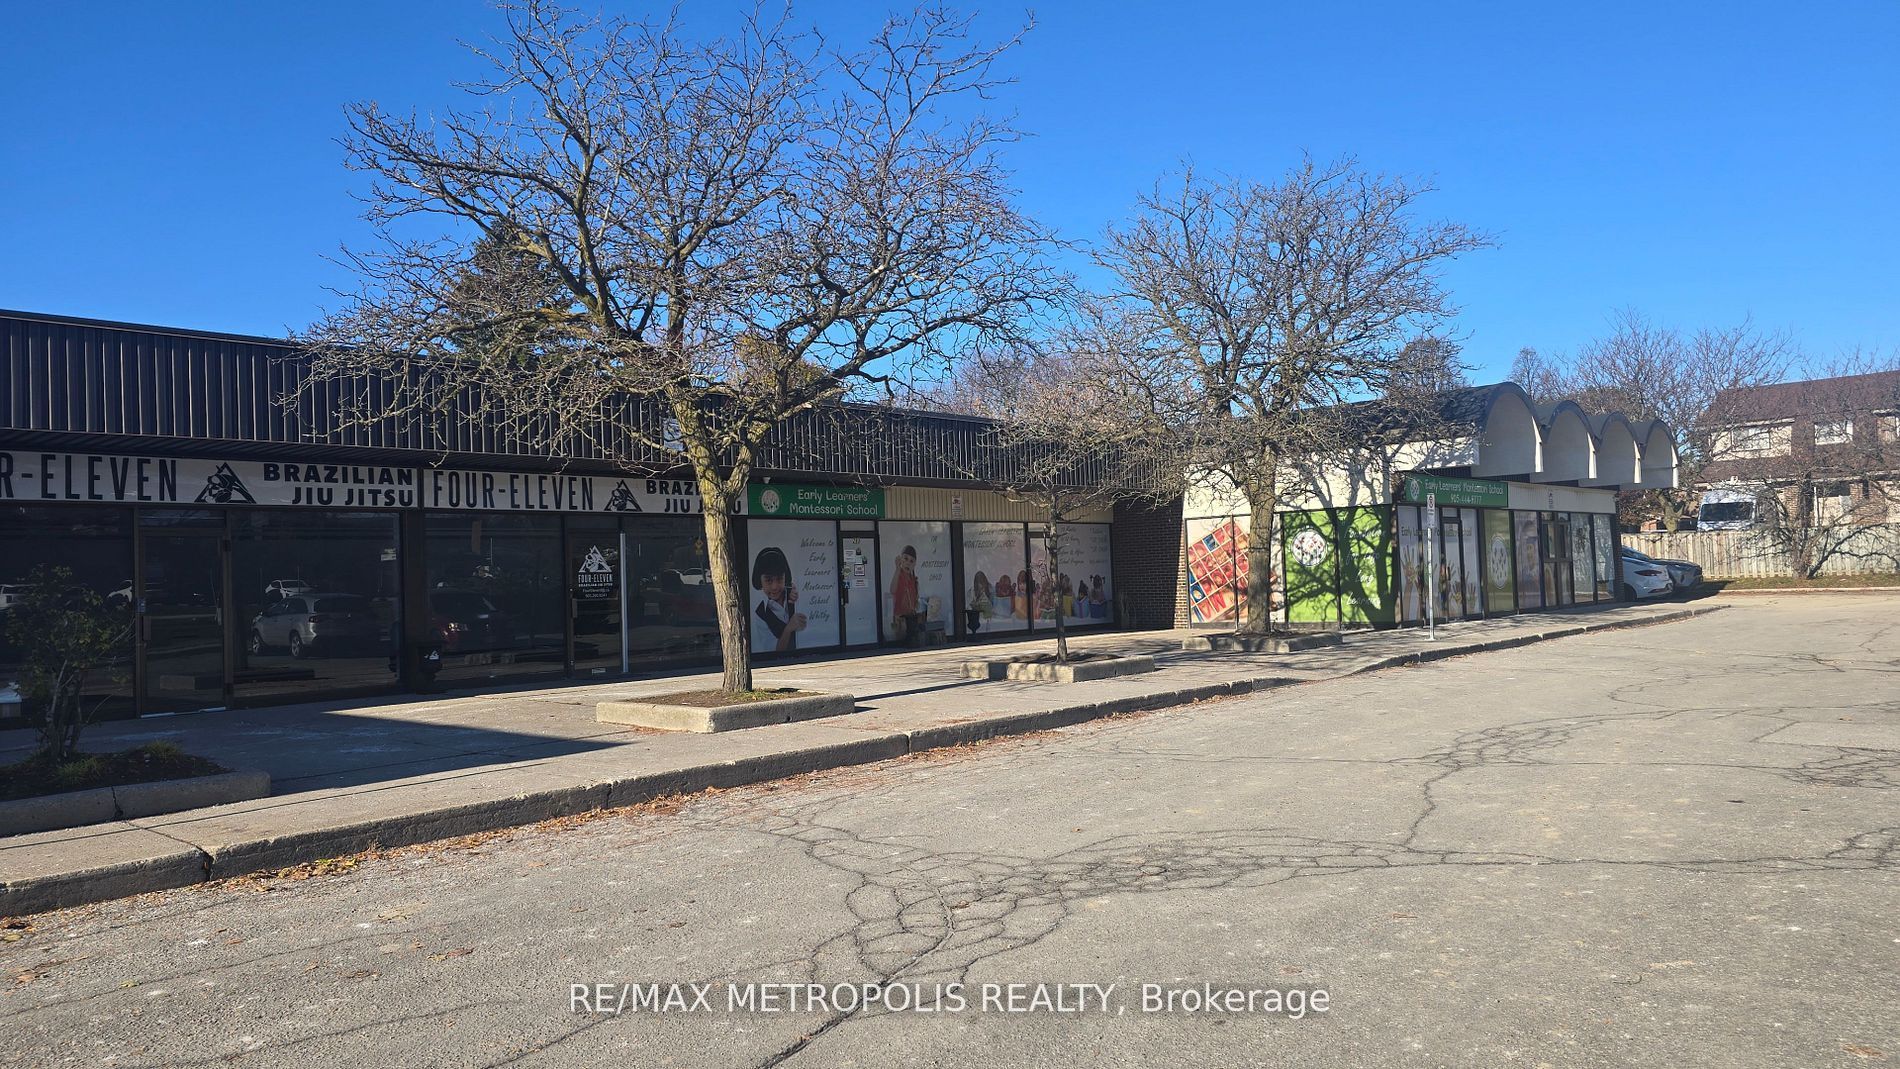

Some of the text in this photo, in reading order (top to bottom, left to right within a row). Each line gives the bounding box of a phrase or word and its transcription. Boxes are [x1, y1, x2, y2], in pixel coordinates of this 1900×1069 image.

[0, 452, 177, 502] R-ELEVEN
[263, 463, 412, 486] BRAZILIAN
[433, 470, 594, 511] FOUR-ELEVEN
[646, 480, 700, 496] BRAZI
[292, 487, 413, 507] JIU JITSU
[798, 489, 823, 504] Early
[664, 498, 691, 513] JIU
[789, 502, 878, 515] Montessori School
[809, 551, 826, 565] Early
[578, 574, 613, 583] FOUR-ELEVEN
[809, 594, 831, 606] School
